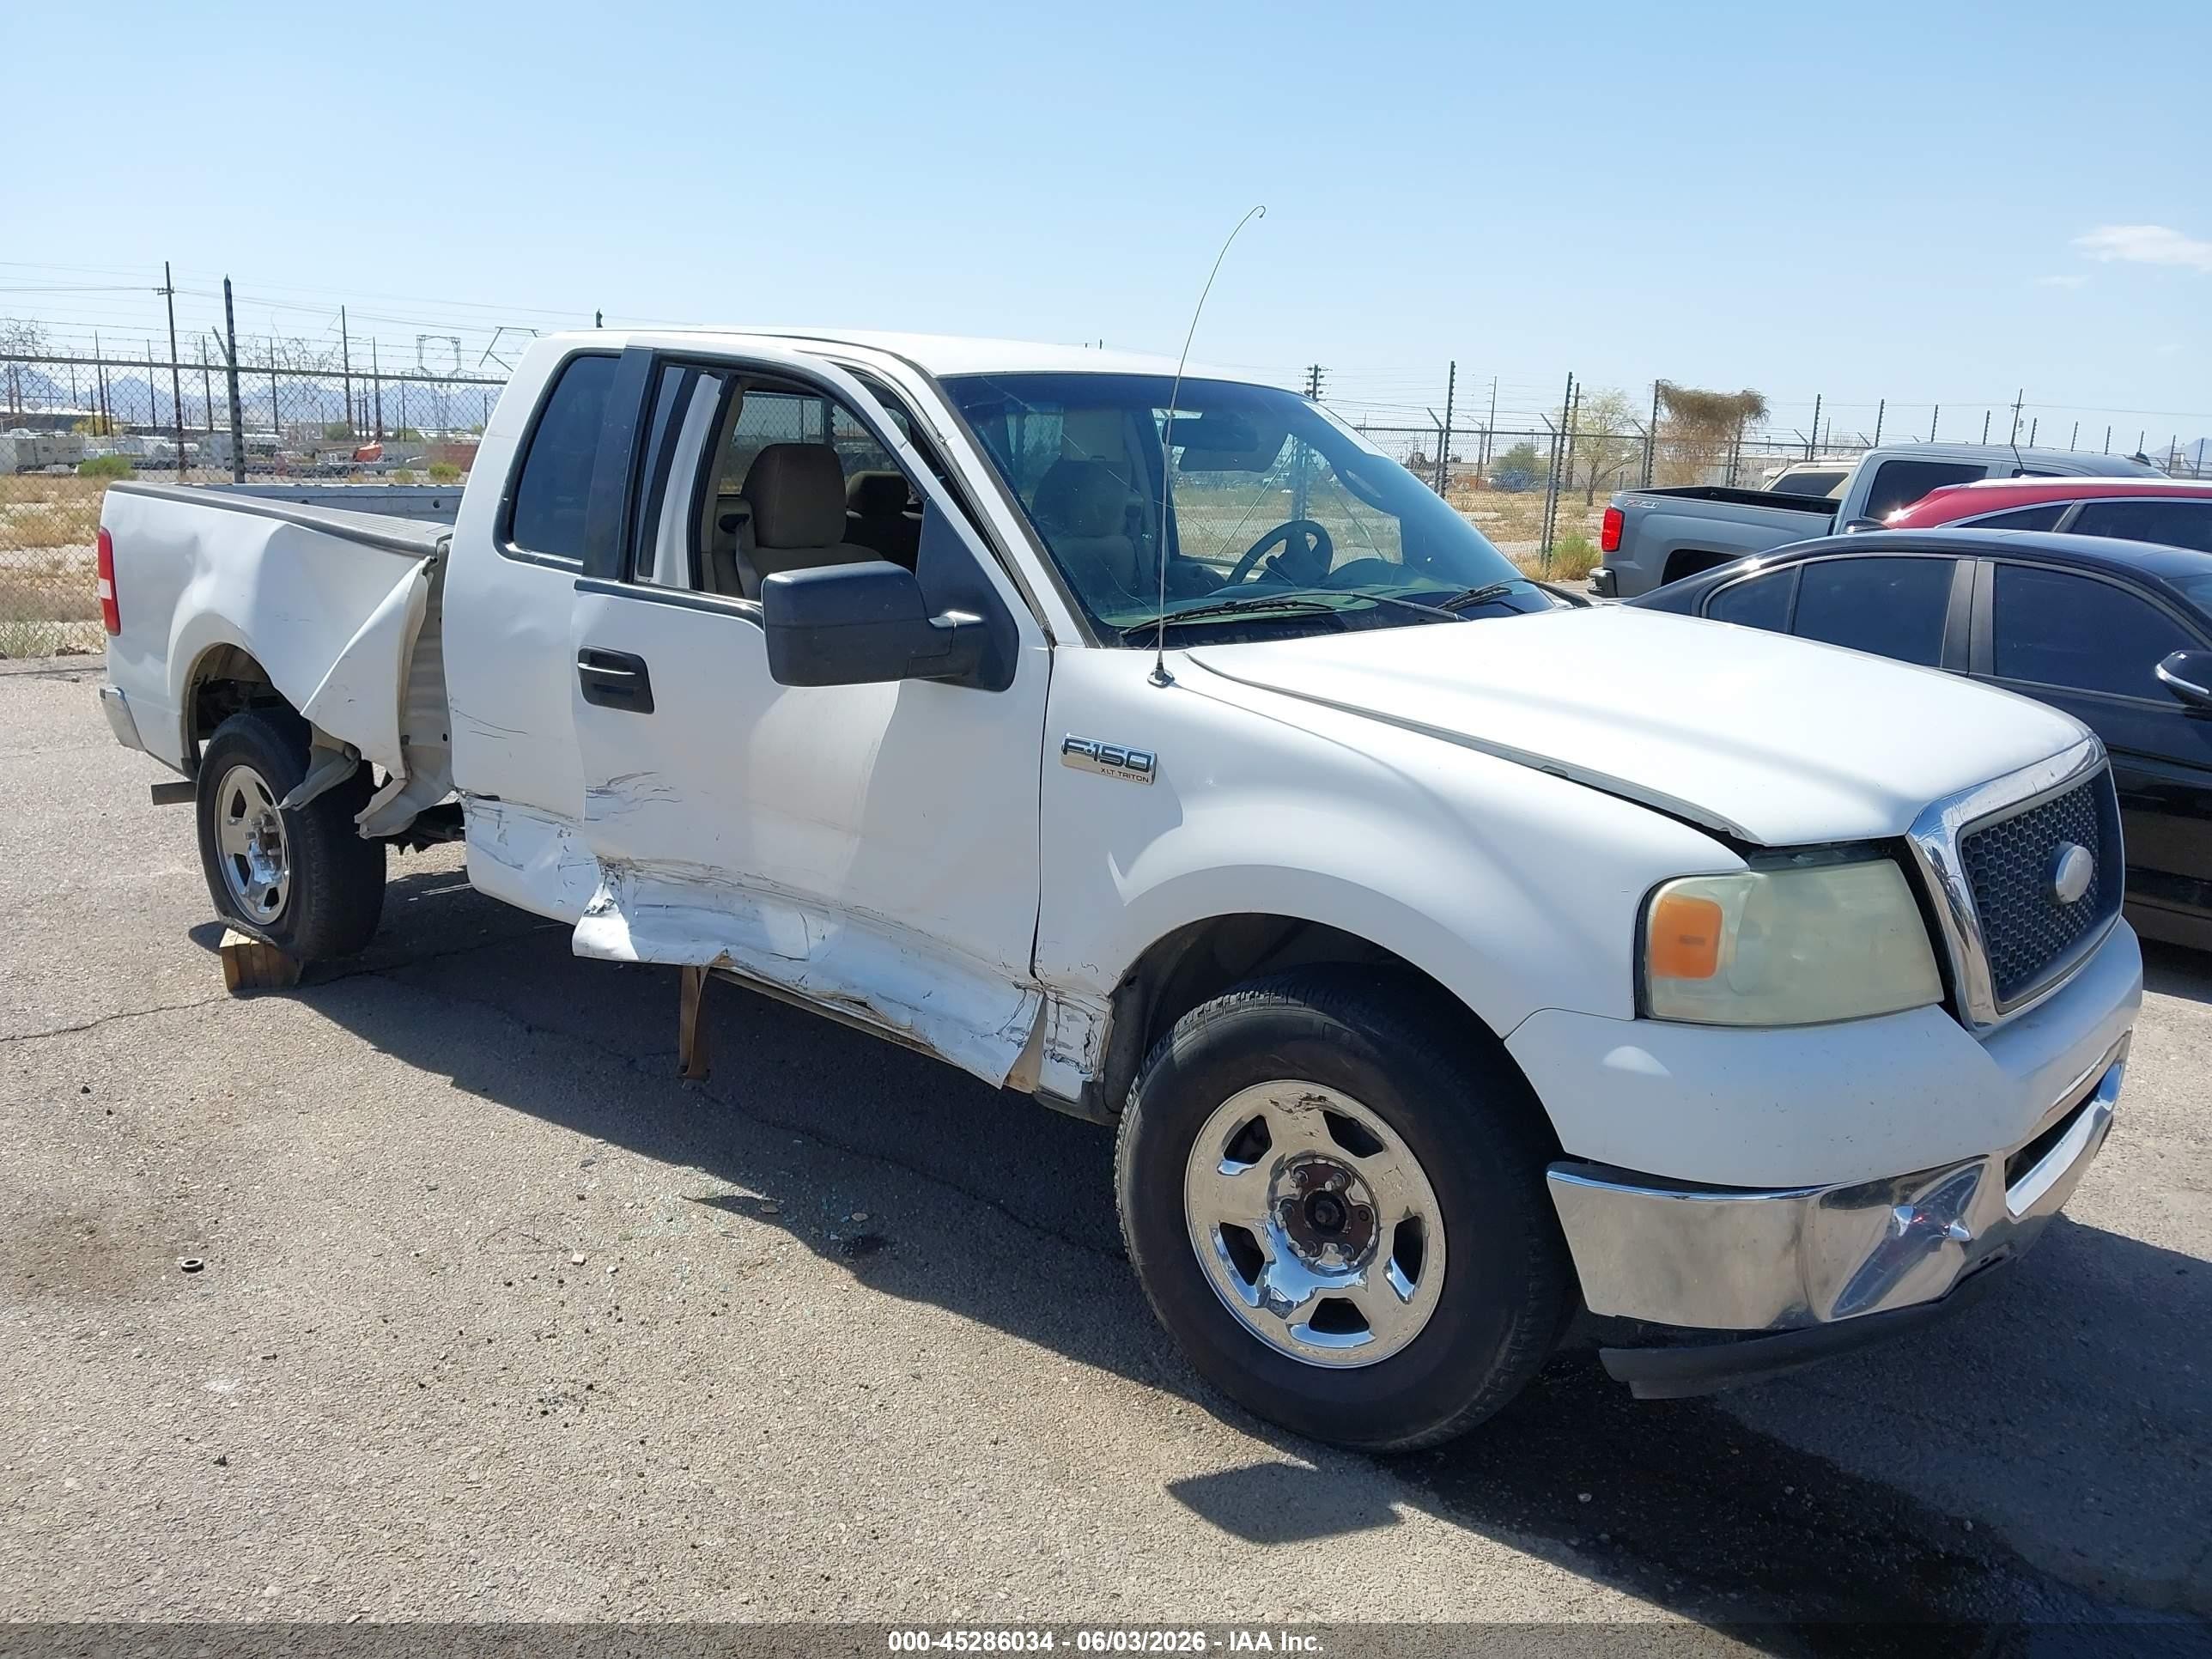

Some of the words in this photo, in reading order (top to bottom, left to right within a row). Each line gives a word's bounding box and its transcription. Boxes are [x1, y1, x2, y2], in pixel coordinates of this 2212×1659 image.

[1062, 738, 1152, 773] F-150
[1100, 767, 1115, 775] XLT
[1117, 770, 1149, 783] TRITON
